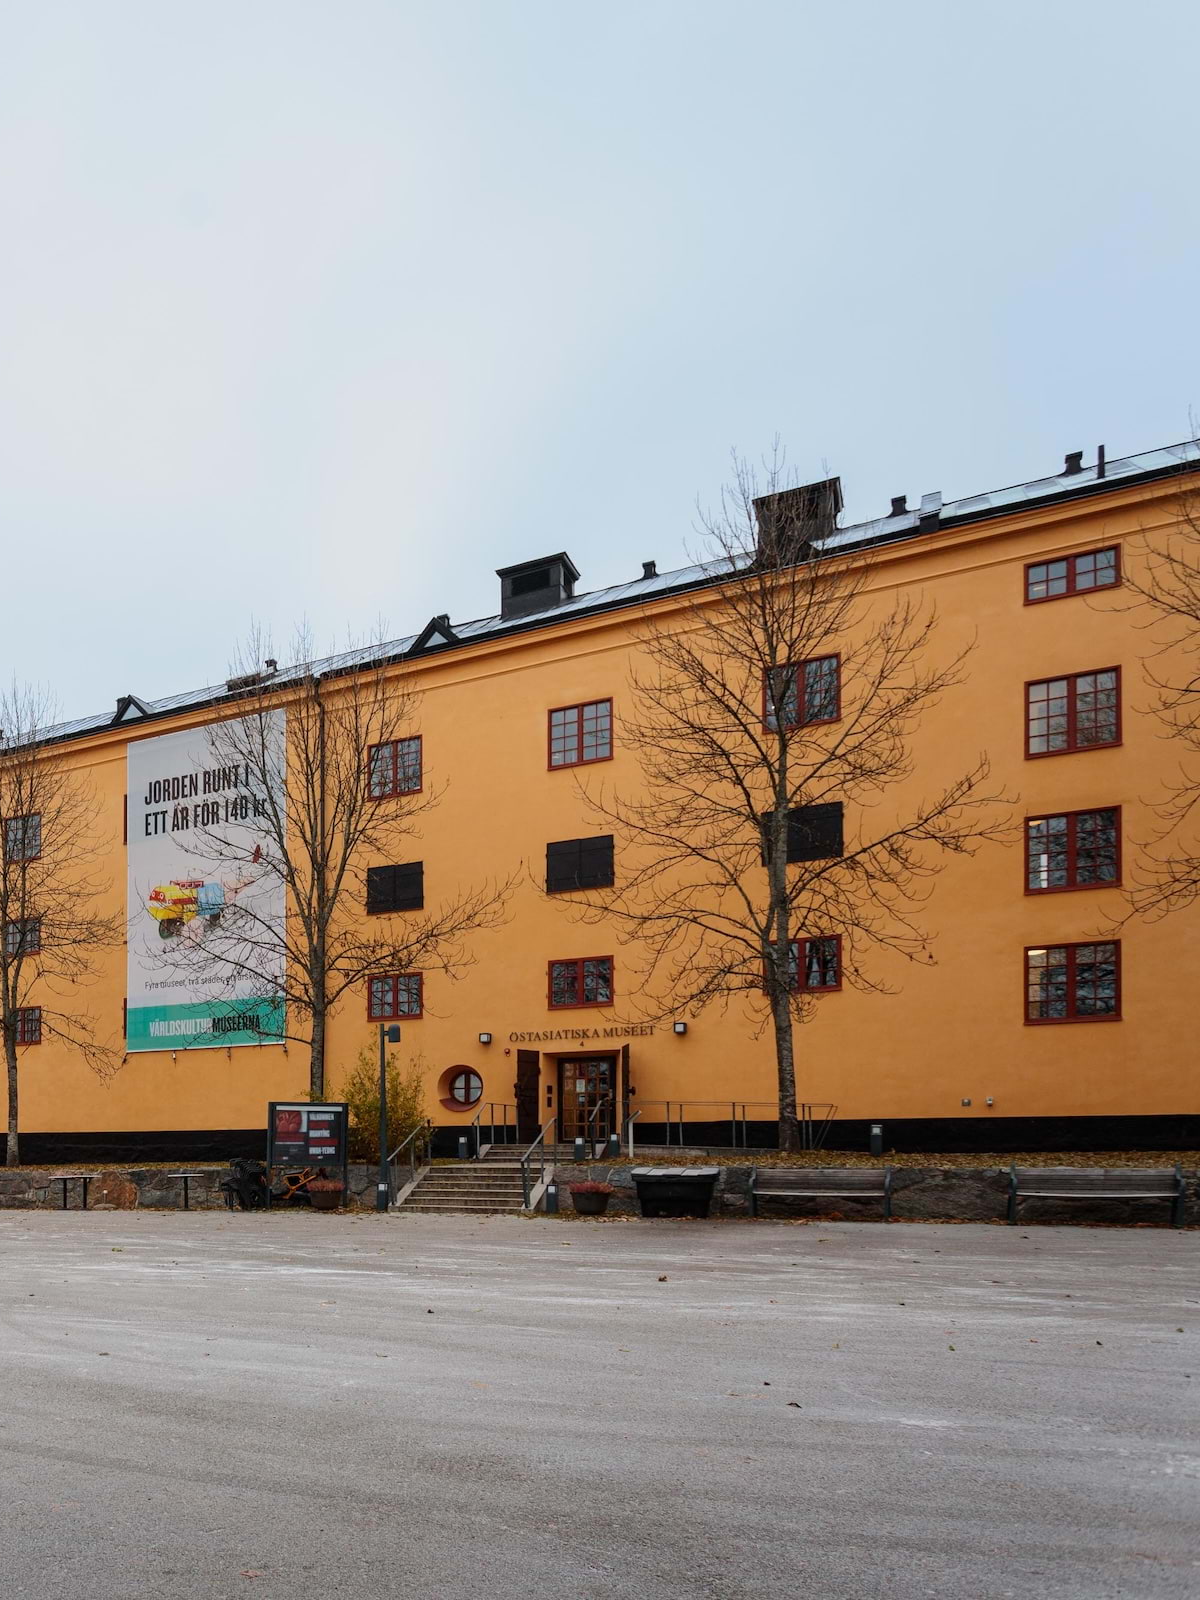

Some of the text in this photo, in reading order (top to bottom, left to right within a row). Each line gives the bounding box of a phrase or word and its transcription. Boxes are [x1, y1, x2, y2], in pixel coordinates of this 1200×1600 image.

[145, 773, 198, 805] JORDEN
[203, 765, 240, 794] RUNT
[145, 810, 168, 836] ETT
[172, 802, 189, 832] ÅR
[194, 799, 220, 828] FÖR
[225, 795, 248, 822] 140
[144, 981, 159, 991] Fyra
[509, 1025, 656, 1042] ÖSTASIATISKA MUSEET
